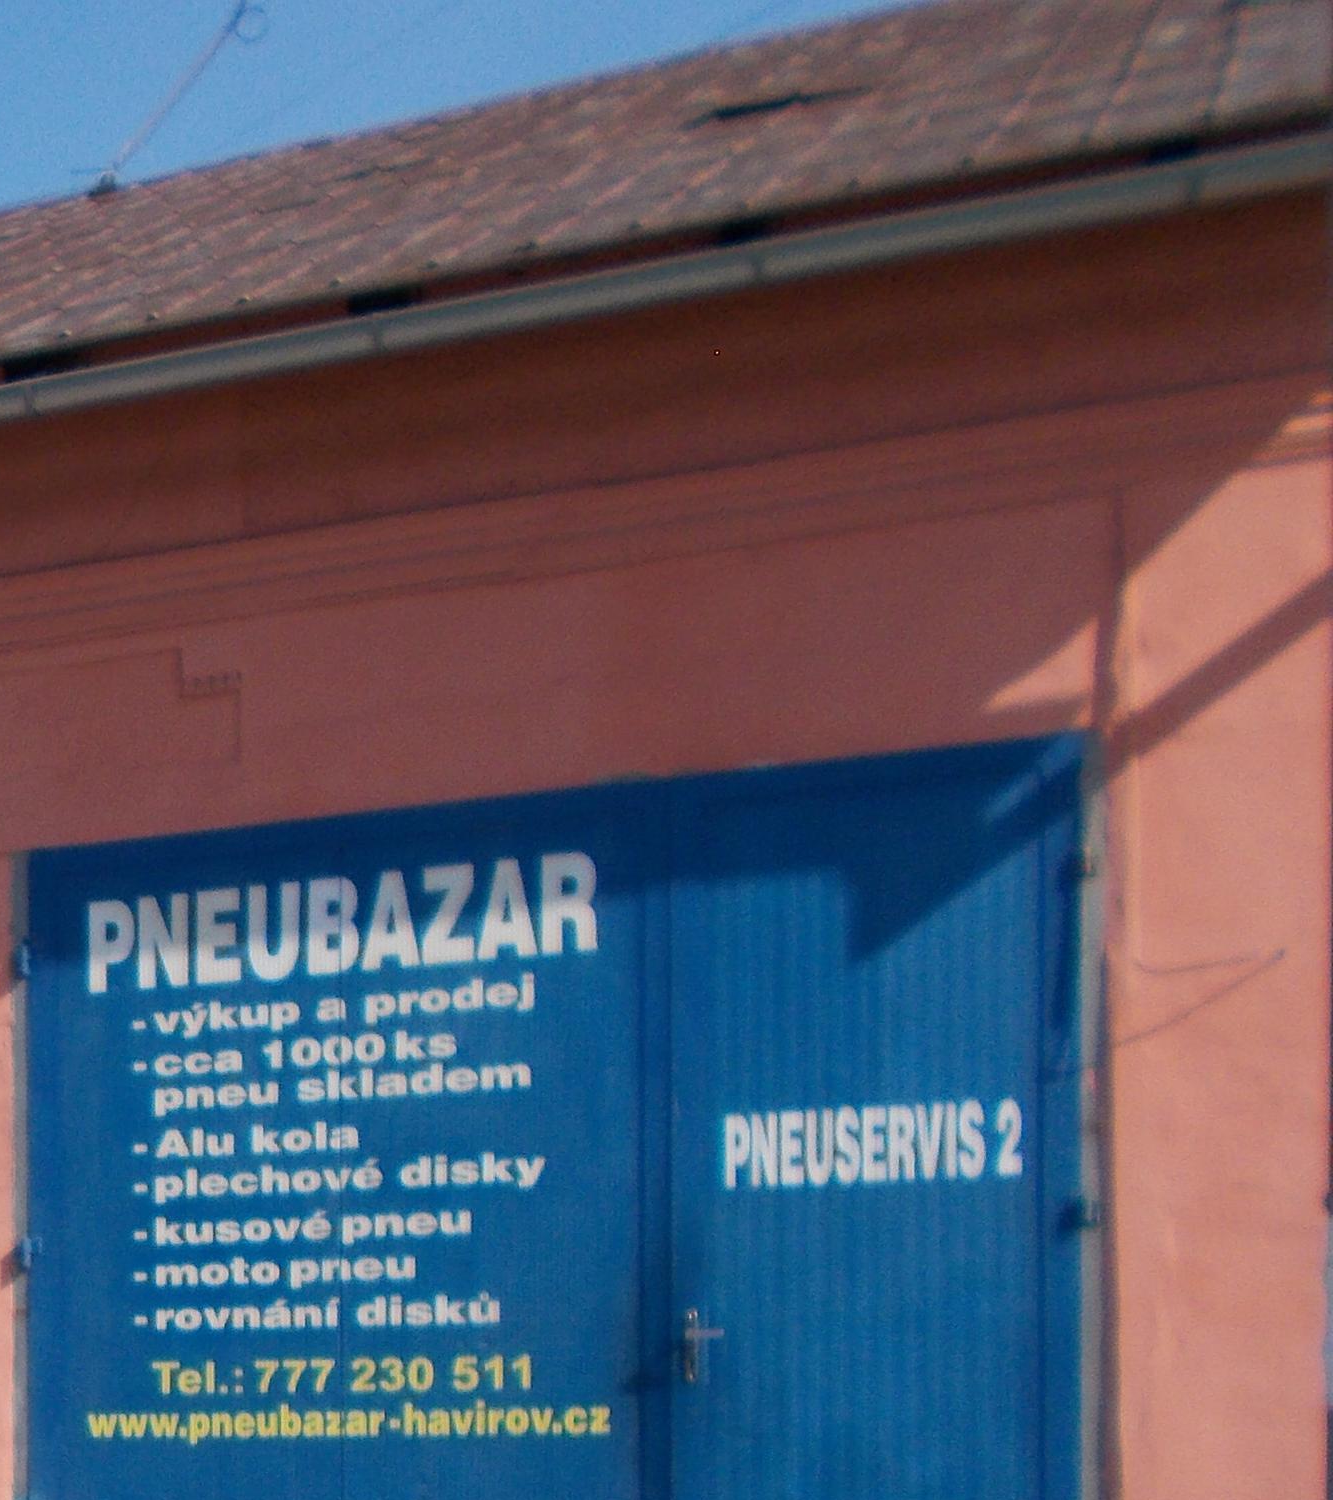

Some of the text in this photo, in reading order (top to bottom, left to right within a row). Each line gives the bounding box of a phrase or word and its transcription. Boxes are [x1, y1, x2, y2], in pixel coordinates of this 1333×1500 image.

[87, 851, 599, 993] PNEUBAZAR
[317, 997, 346, 1022] a
[364, 972, 535, 1024] prodej
[263, 1033, 386, 1069] 1000
[395, 1029, 457, 1061] ks
[153, 1061, 532, 1117] pneu skladem
[252, 1121, 359, 1153] kola
[724, 1098, 1023, 1188] PNEUSERVIS 2
[399, 1152, 546, 1190] disky
[341, 1208, 473, 1246] pneu
[289, 1254, 416, 1290] pneu
[356, 1292, 501, 1328] disků
[152, 1353, 533, 1395] Tel.: 777 230 511
[87, 1401, 613, 1446] www.pneubazar-havirov.cz
